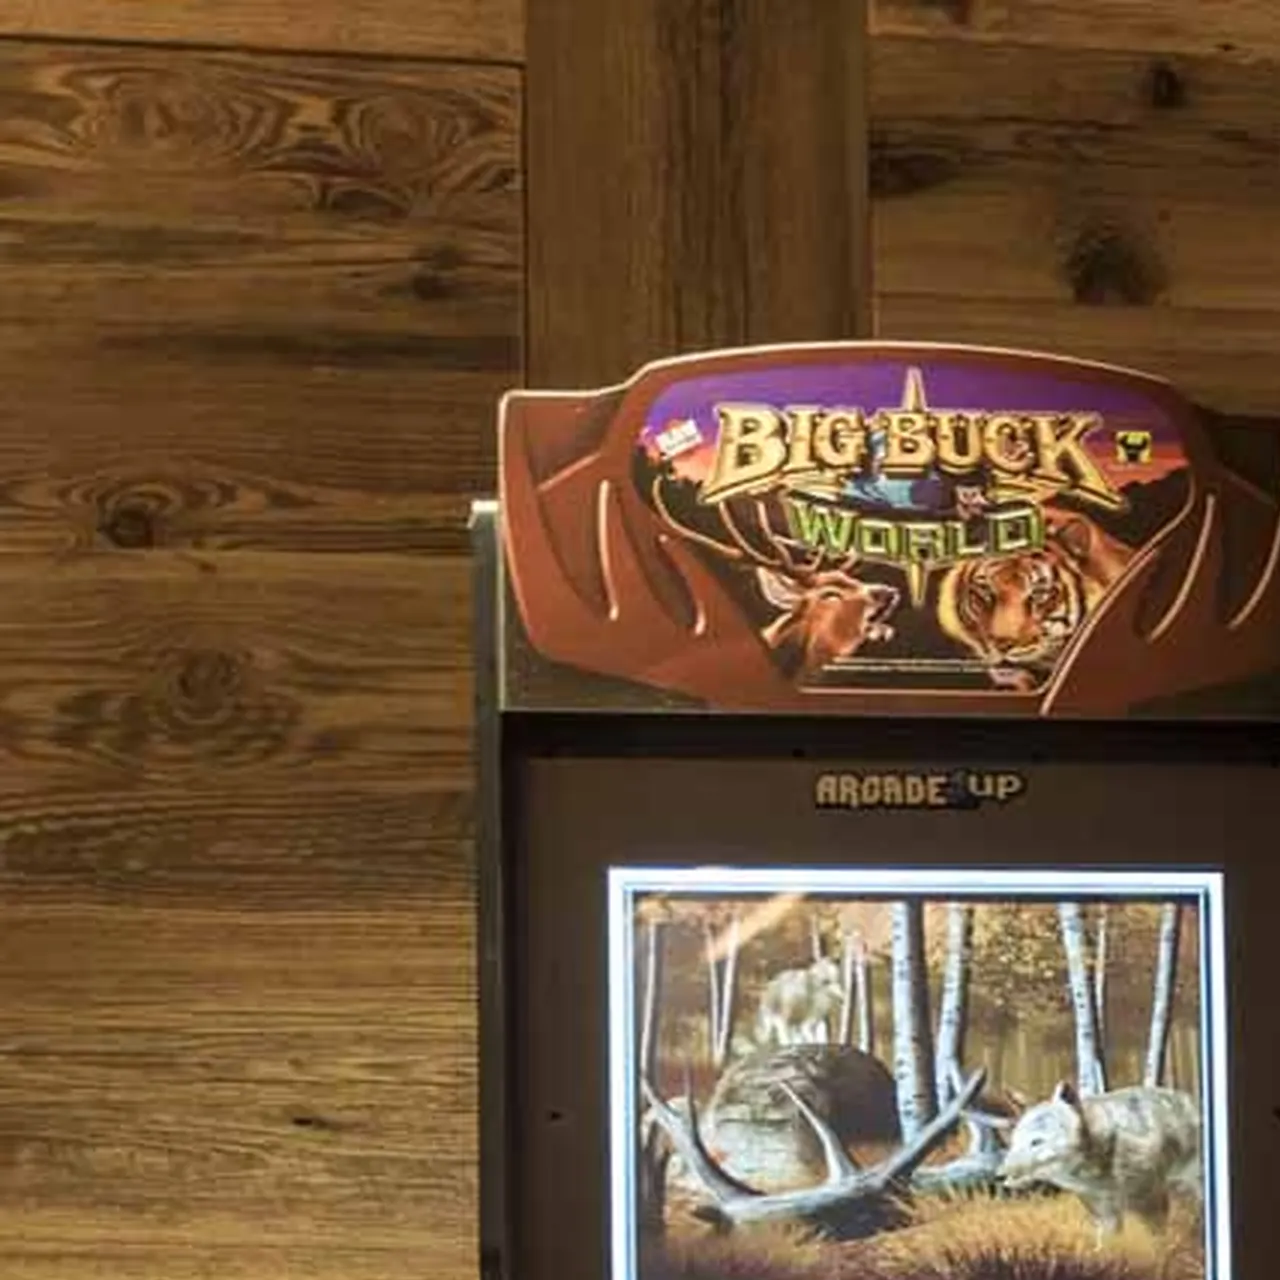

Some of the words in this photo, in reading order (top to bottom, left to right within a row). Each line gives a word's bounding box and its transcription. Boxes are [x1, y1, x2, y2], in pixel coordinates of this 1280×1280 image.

[700, 402, 866, 503] BIG
[884, 406, 1128, 510] BUCK
[789, 502, 1046, 563] WORLD
